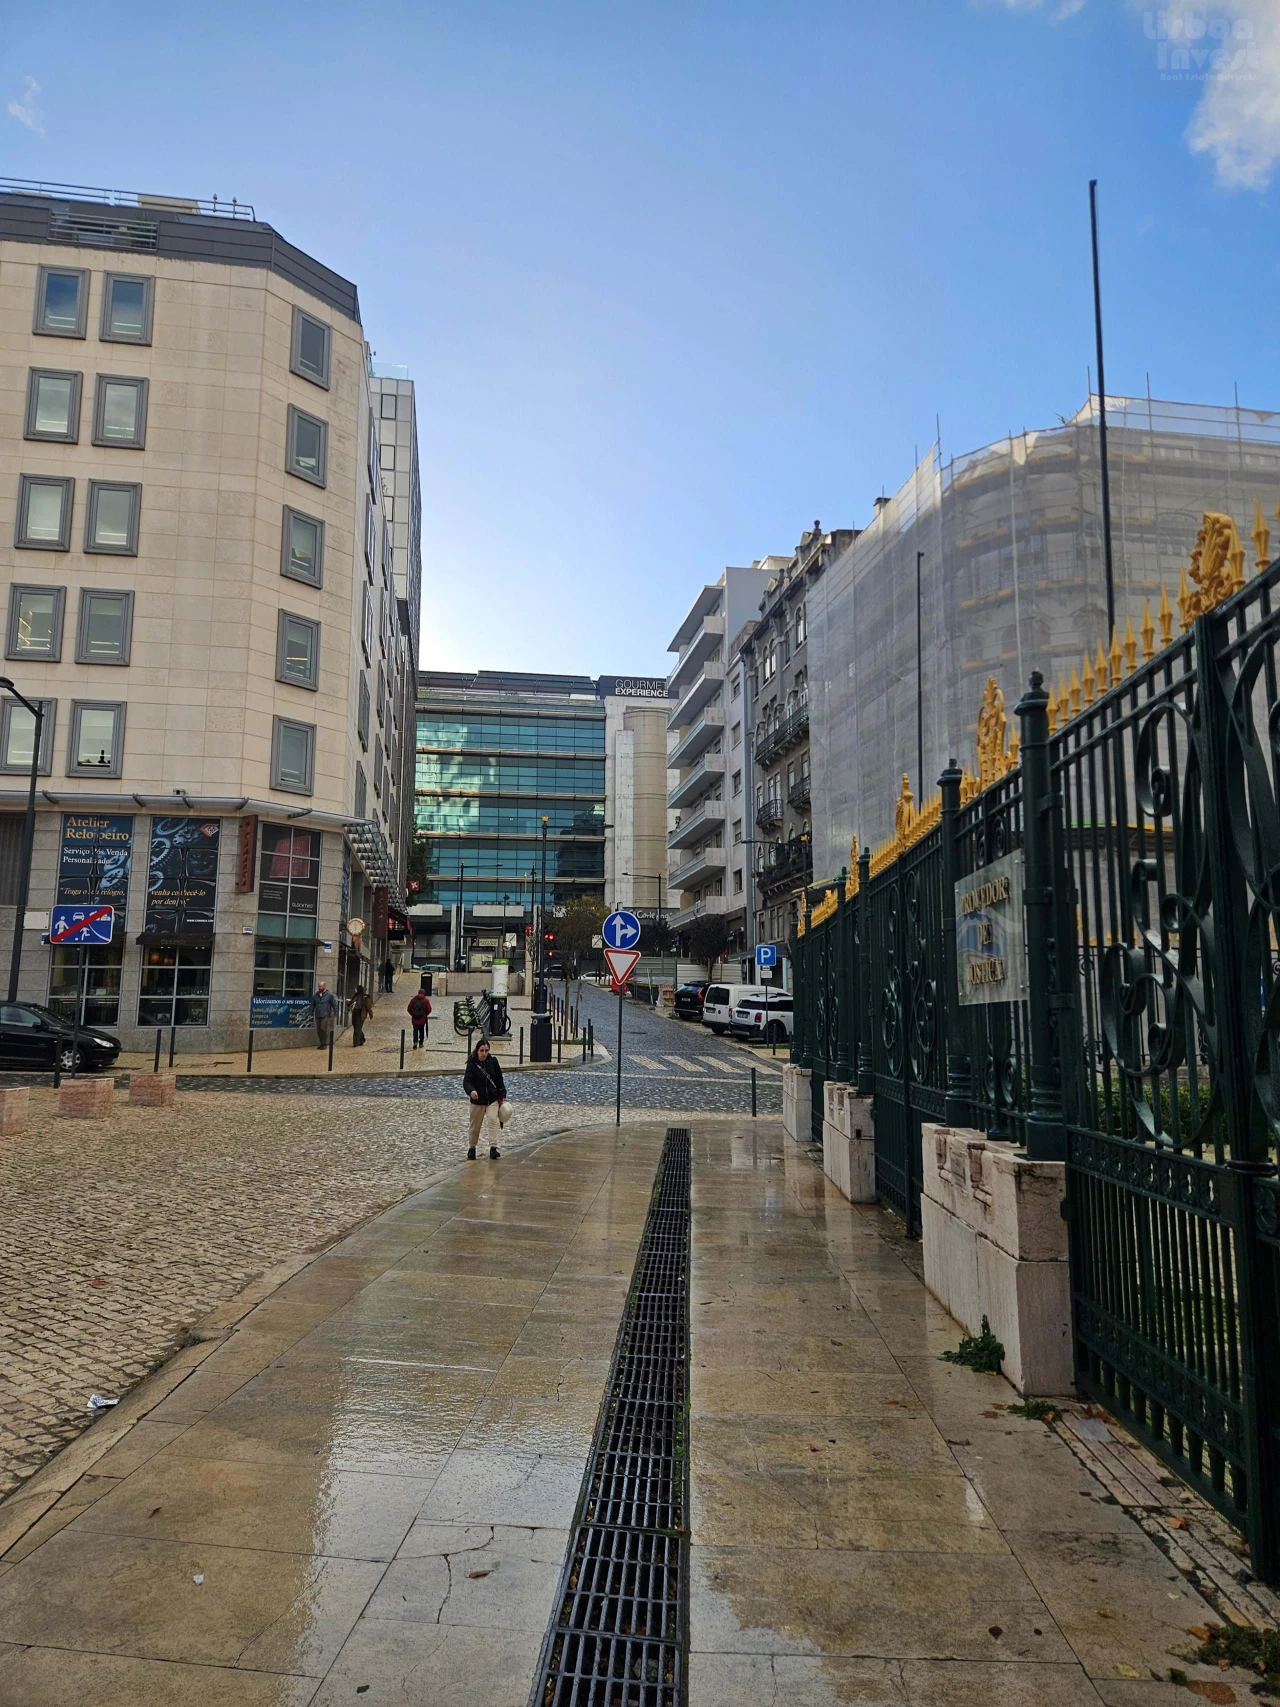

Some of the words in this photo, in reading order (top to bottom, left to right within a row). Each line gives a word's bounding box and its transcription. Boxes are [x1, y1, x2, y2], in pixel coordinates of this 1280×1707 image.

[615, 679, 667, 689] GOURMET
[615, 688, 668, 697] EXPERIENCE
[66, 816, 110, 828] Atelier
[63, 847, 91, 857] Serviço
[106, 848, 128, 857] Venda
[636, 910, 656, 919] Corte
[760, 948, 771, 963] P
